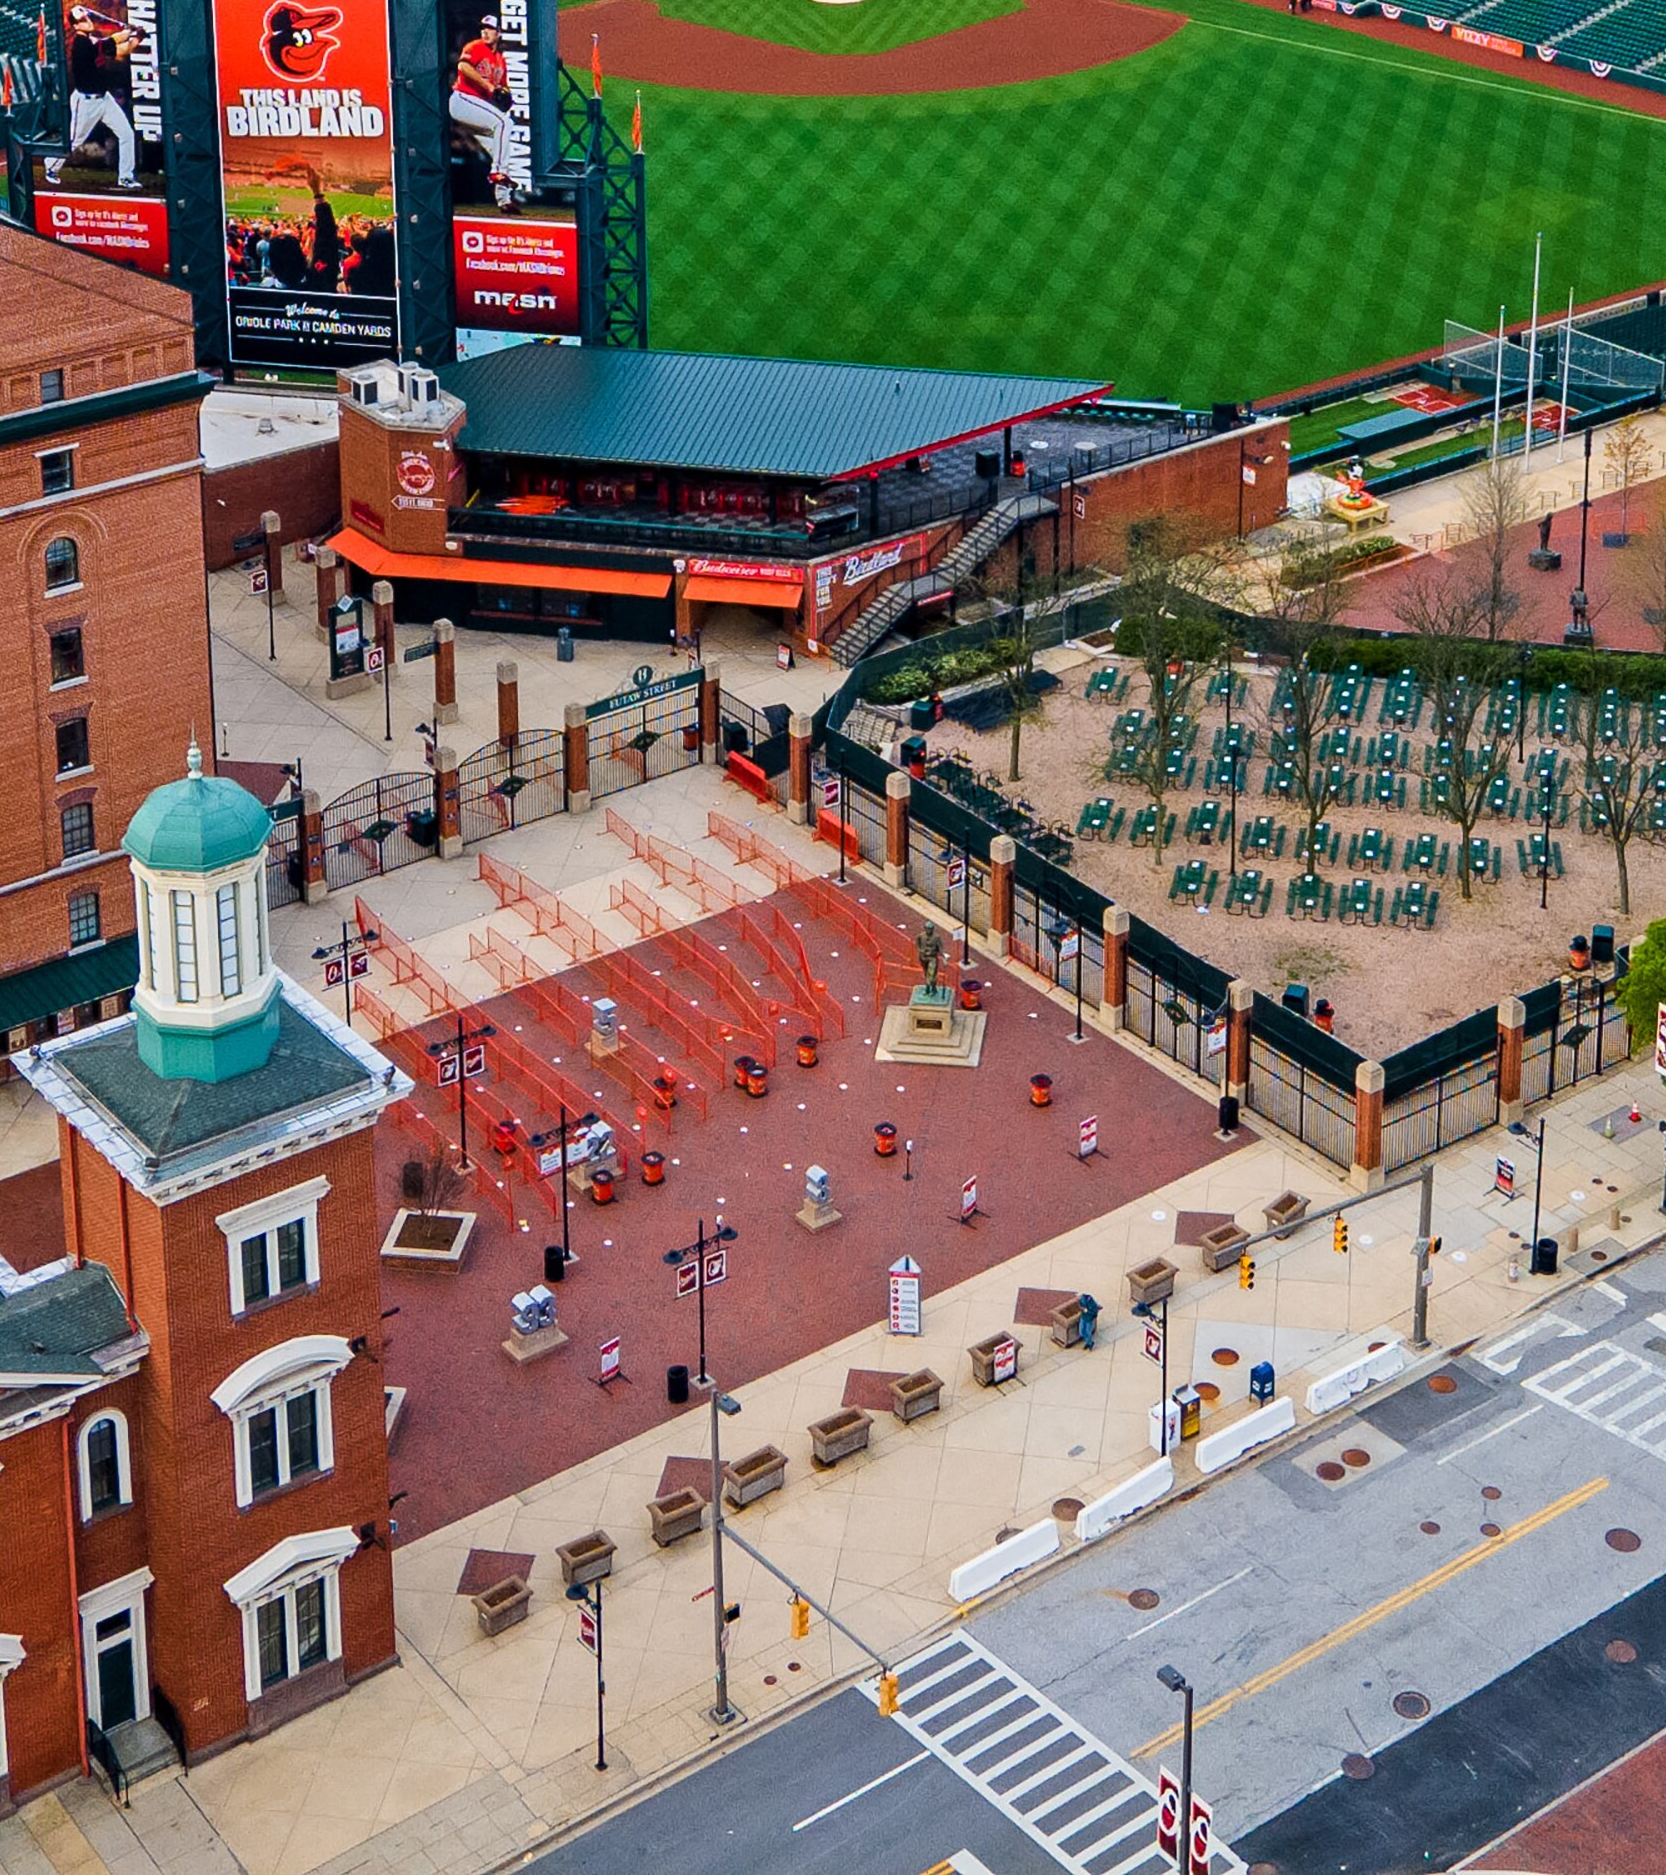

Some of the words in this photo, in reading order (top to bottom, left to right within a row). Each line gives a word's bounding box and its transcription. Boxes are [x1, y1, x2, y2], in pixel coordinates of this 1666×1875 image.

[239, 88, 286, 108] THIS
[287, 88, 340, 108] LAND
[342, 88, 362, 108] IS
[501, 50, 531, 120] MORE
[132, 104, 163, 141] UP
[226, 106, 384, 137] BIRDLAND
[285, 302, 328, 317] Welcome
[235, 316, 271, 330] ORIOLE
[273, 318, 301, 331] PARK
[312, 321, 356, 335] CAMDEN
[357, 325, 392, 338] YARDS
[691, 559, 758, 576] Budweiser
[843, 543, 904, 585] Birdland
[608, 690, 641, 709] EUTAW
[643, 679, 677, 698] STREET
